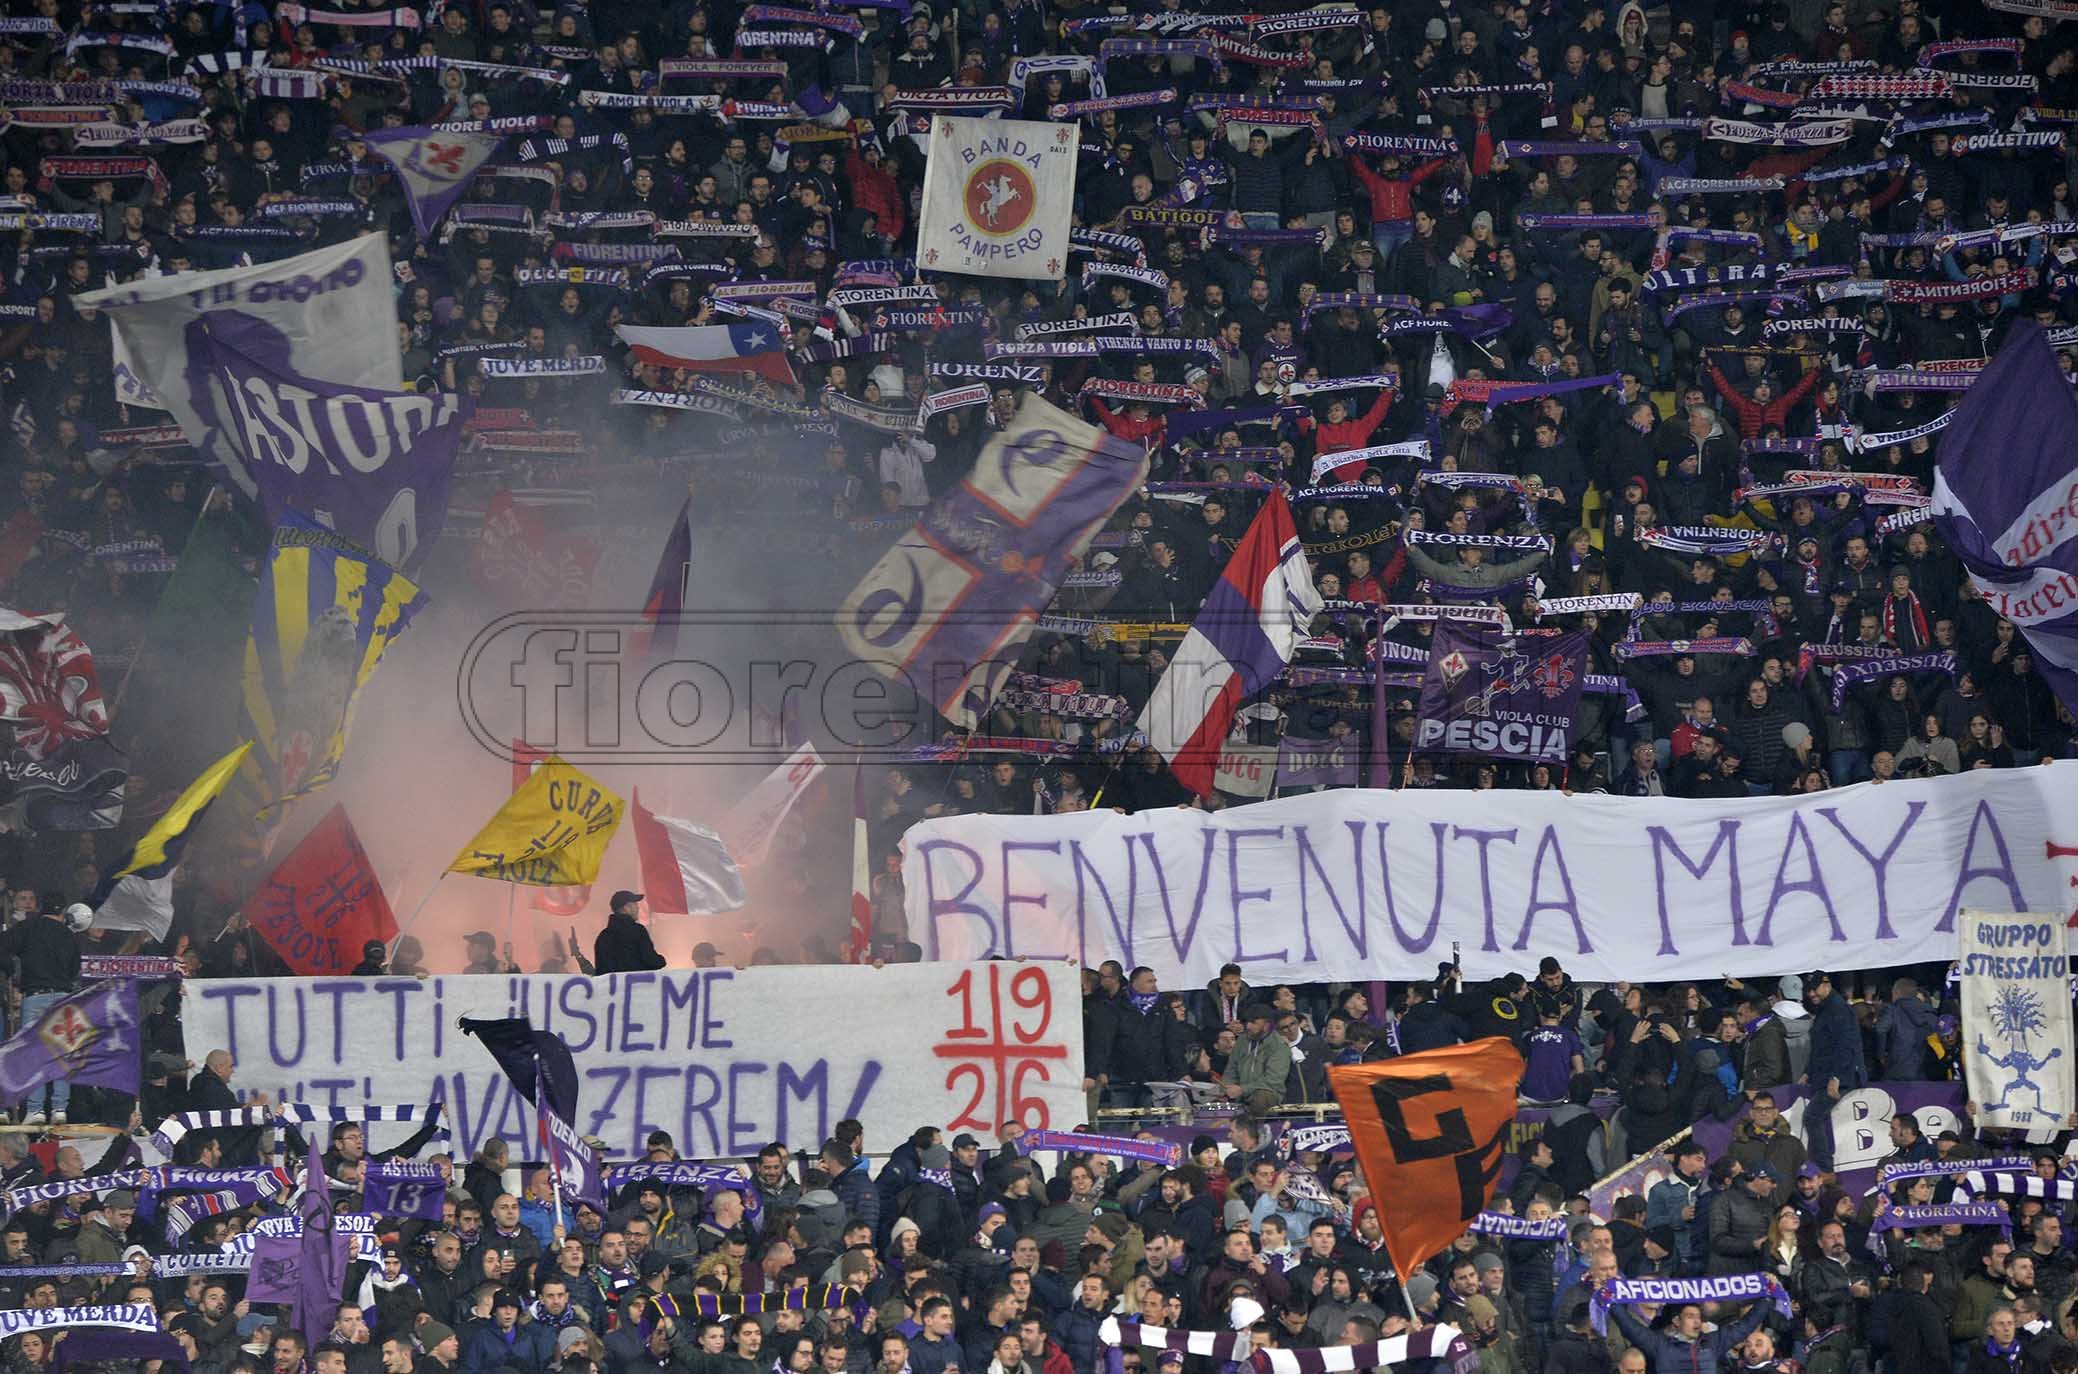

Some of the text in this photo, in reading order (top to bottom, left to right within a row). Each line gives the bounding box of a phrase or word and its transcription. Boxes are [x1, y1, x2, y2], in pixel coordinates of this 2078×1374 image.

[1257, 14, 1360, 34] FIORENTINA
[896, 88, 948, 102] ORZA
[491, 115, 538, 130] VIOLA
[1358, 134, 1447, 153] FIORENTINA
[1969, 130, 2062, 150] COLLETTIVO
[961, 136, 1042, 169] BANDA
[266, 202, 354, 216] ACF FIORENTINA
[1131, 208, 1218, 225] BATIGOL
[949, 223, 1044, 260] PAMPERO
[836, 287, 935, 304] FIORENTINA
[1020, 311, 1134, 337] FIORENTINA
[997, 341, 1098, 356] FORZA VIOLA
[1096, 336, 1143, 351] FIRENZE
[1146, 337, 1180, 351] VANTO
[485, 359, 539, 375] JUVE
[1299, 487, 1317, 499] ACF
[1888, 507, 1933, 529] FIREN
[1410, 530, 1549, 551] FIORENZA
[1551, 594, 1635, 611] FIORENTIN
[1495, 710, 1570, 729] VIOLA CLUB
[1417, 718, 1567, 762] PESCIA
[1217, 752, 1262, 782] OCG
[917, 799, 2030, 971] BENVENUTA MAYA
[1977, 923, 2052, 949] GRUPPO
[1963, 952, 2067, 980] STRESSATO
[387, 1183, 427, 1213] 13
[1909, 1203, 1999, 1219] FIORENTINA
[166, 1254, 251, 1270] COLLETTI
[1615, 1274, 1762, 1301] AFICIONADOS
[64, 1302, 158, 1327] MERDA
